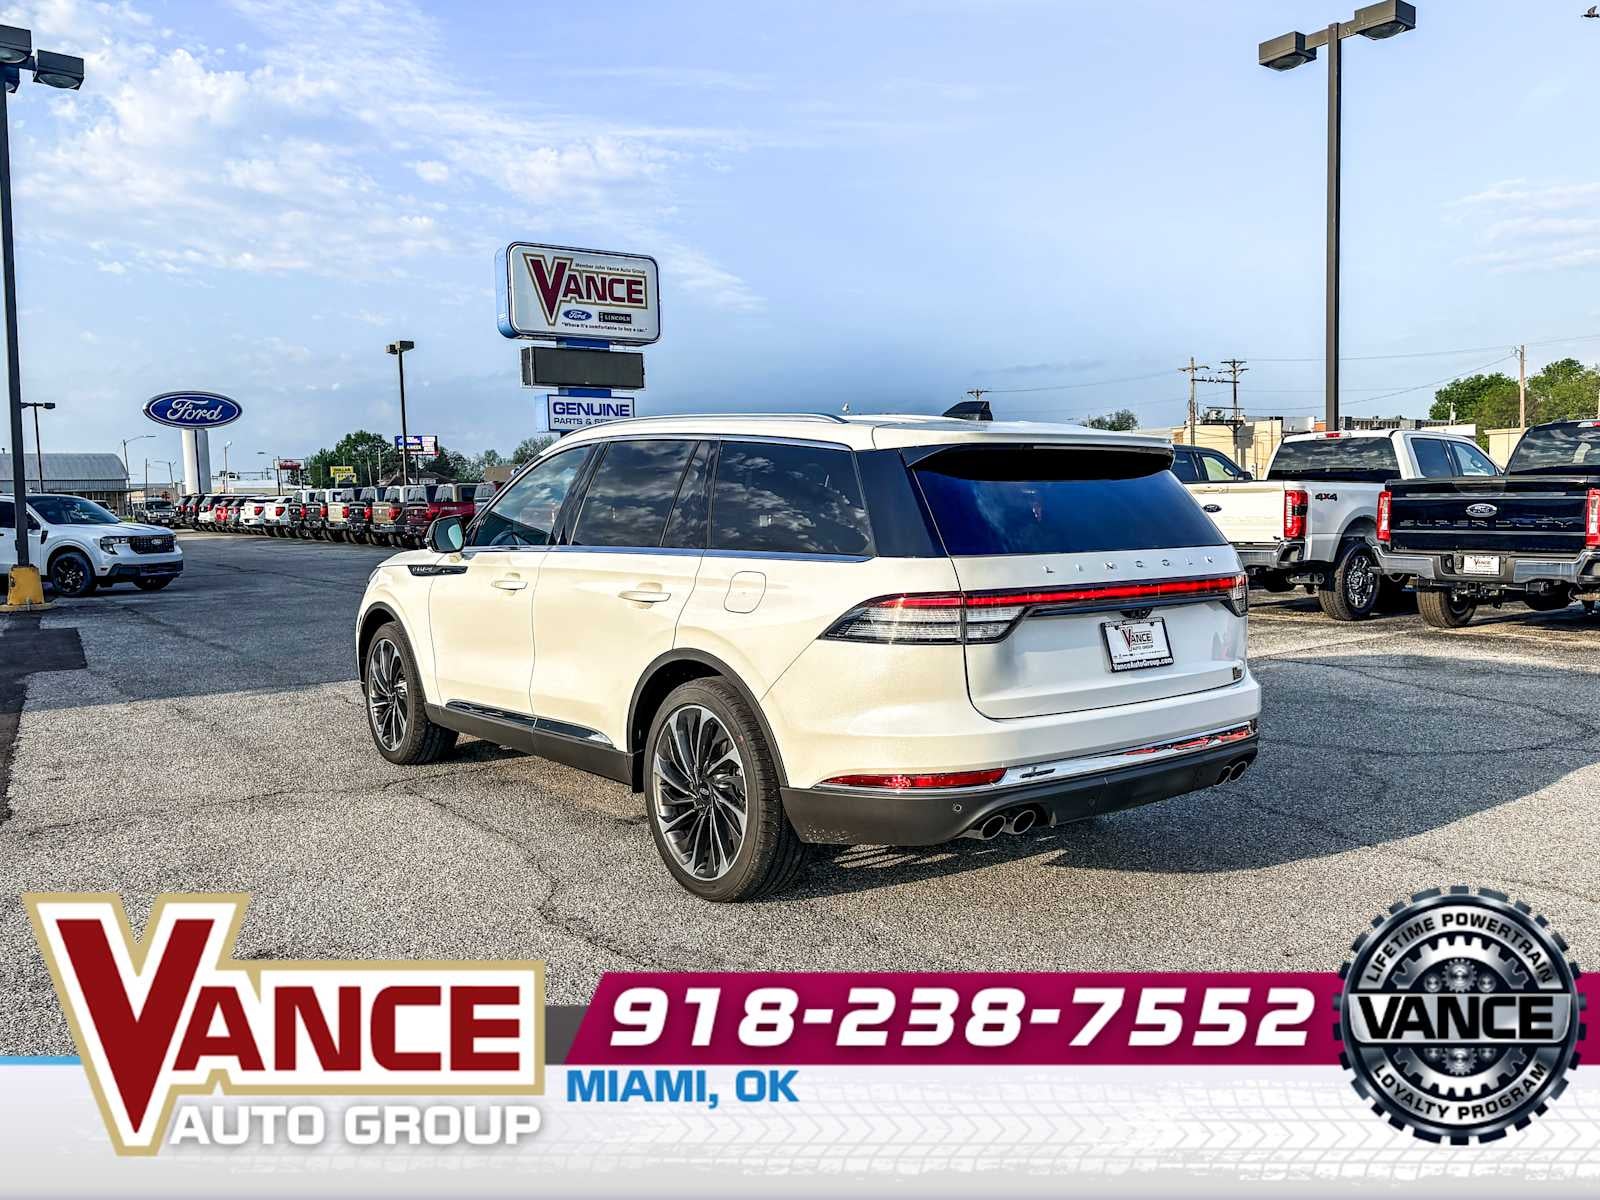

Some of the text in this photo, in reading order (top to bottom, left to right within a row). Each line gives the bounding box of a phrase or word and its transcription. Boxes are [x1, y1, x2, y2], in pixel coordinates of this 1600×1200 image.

[529, 258, 644, 319] VANCE
[568, 310, 588, 320] Ford
[604, 314, 632, 322] LINCOLN
[166, 398, 224, 421] Ford
[553, 401, 630, 417] GENUINE
[1399, 519, 1575, 529] SUPER DUTY
[1042, 555, 1216, 575] LINCOLN
[1121, 628, 1152, 648] VANCE
[1113, 657, 1174, 671] VanceAutoGroup.com
